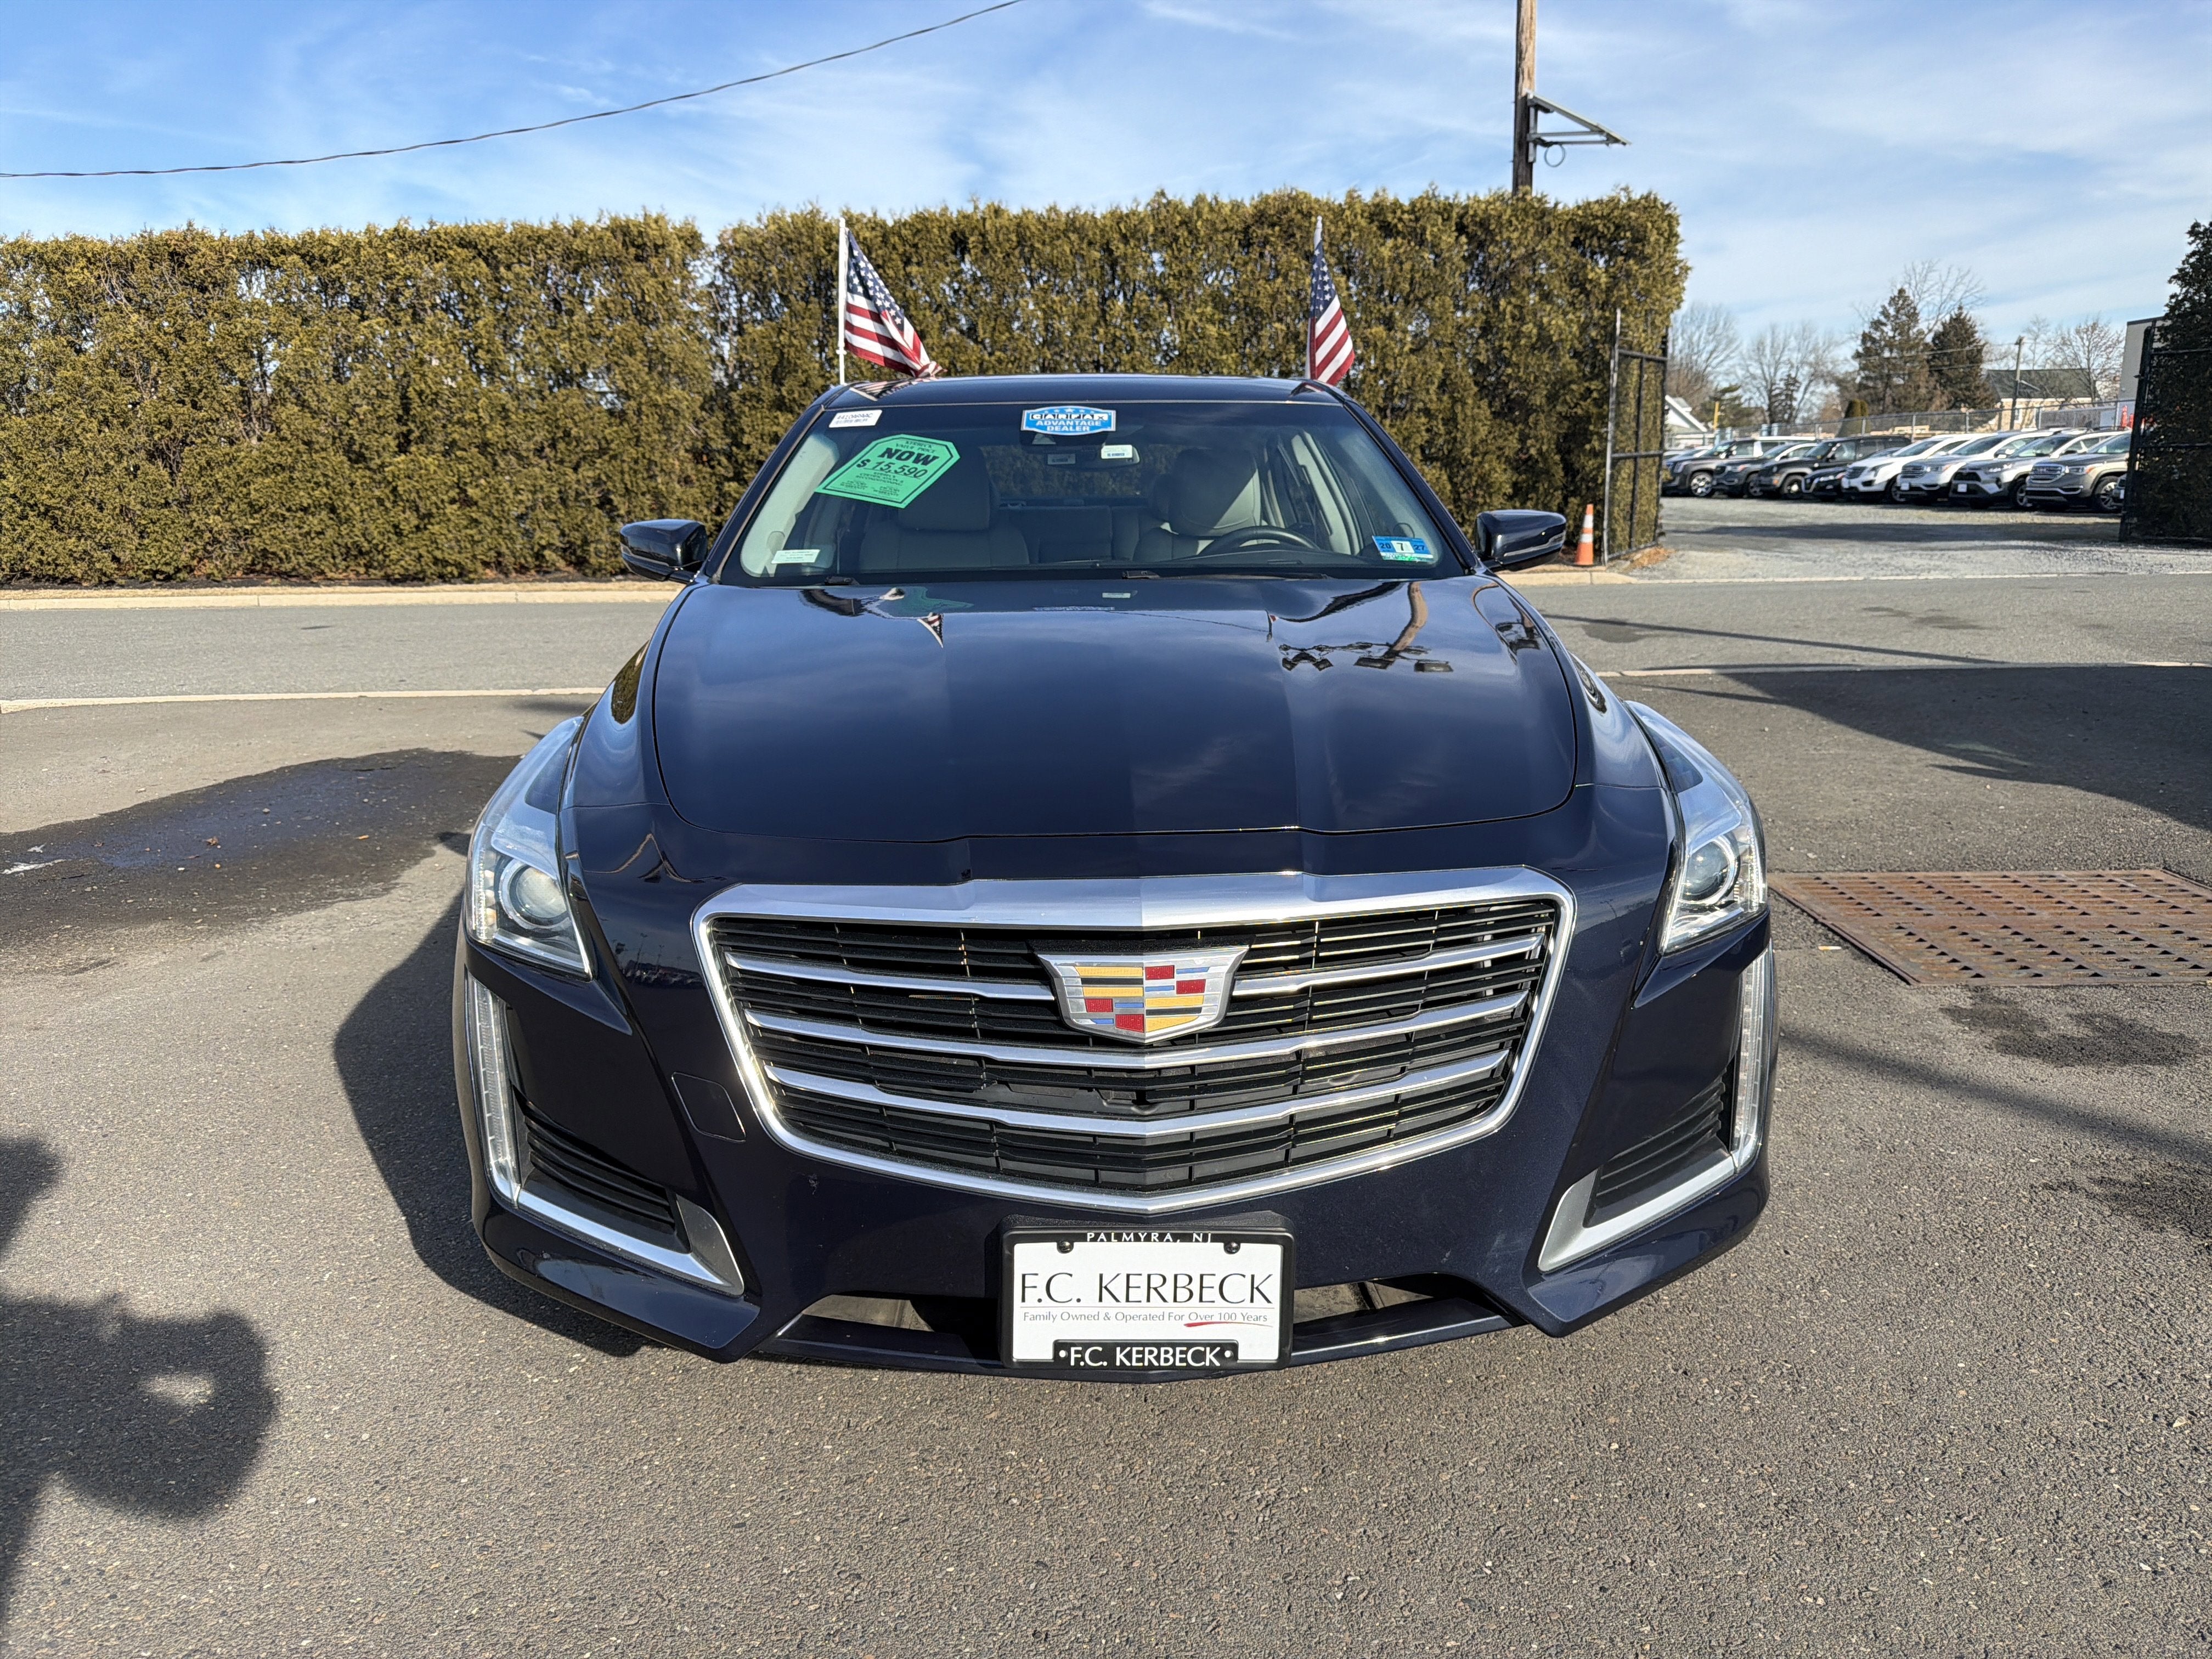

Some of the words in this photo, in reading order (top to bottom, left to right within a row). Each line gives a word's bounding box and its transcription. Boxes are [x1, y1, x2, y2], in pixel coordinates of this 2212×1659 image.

[878, 447, 940, 466] NOW
[1397, 543, 1404, 551] 7
[1087, 1232, 1181, 1243] PALMYRA,
[1193, 1232, 1212, 1244] NJ
[1021, 1272, 1081, 1304] F.C.
[1098, 1272, 1273, 1304] KERBECK
[1023, 1311, 1058, 1323] Family
[1060, 1311, 1100, 1321] Owned
[1103, 1312, 1111, 1321] &
[1115, 1311, 1165, 1323] Operated
[1168, 1312, 1185, 1321] For
[1188, 1312, 1215, 1322] Over
[1218, 1312, 1237, 1322] 100
[1240, 1312, 1268, 1322] Years
[1070, 1346, 1108, 1367] F.C.
[1116, 1346, 1221, 1367] KERBECK
